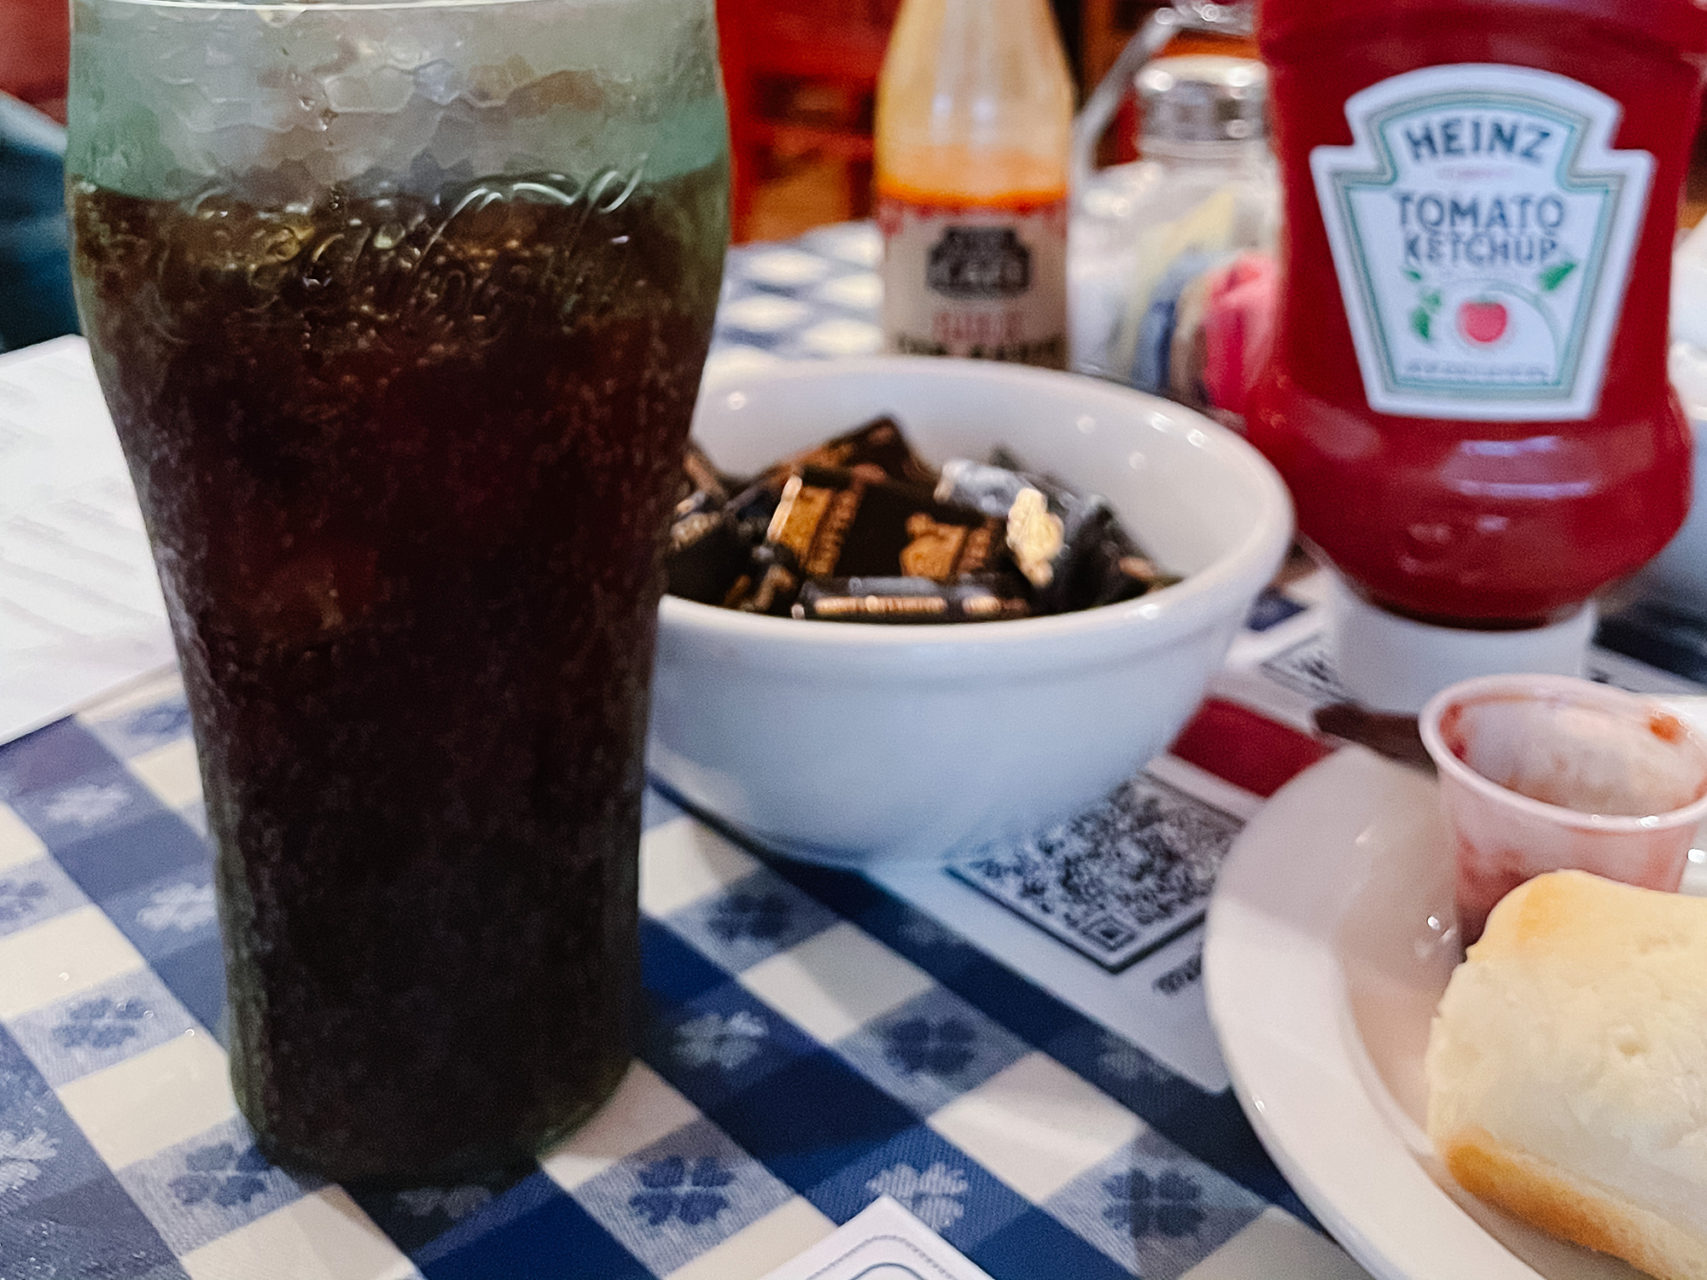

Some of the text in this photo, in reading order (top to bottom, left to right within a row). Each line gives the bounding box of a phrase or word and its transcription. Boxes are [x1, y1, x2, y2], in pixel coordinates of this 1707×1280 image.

[1404, 119, 1551, 162] HEINZ
[1397, 192, 1565, 231] TOMATO
[1404, 234, 1558, 265] KETCHUP
